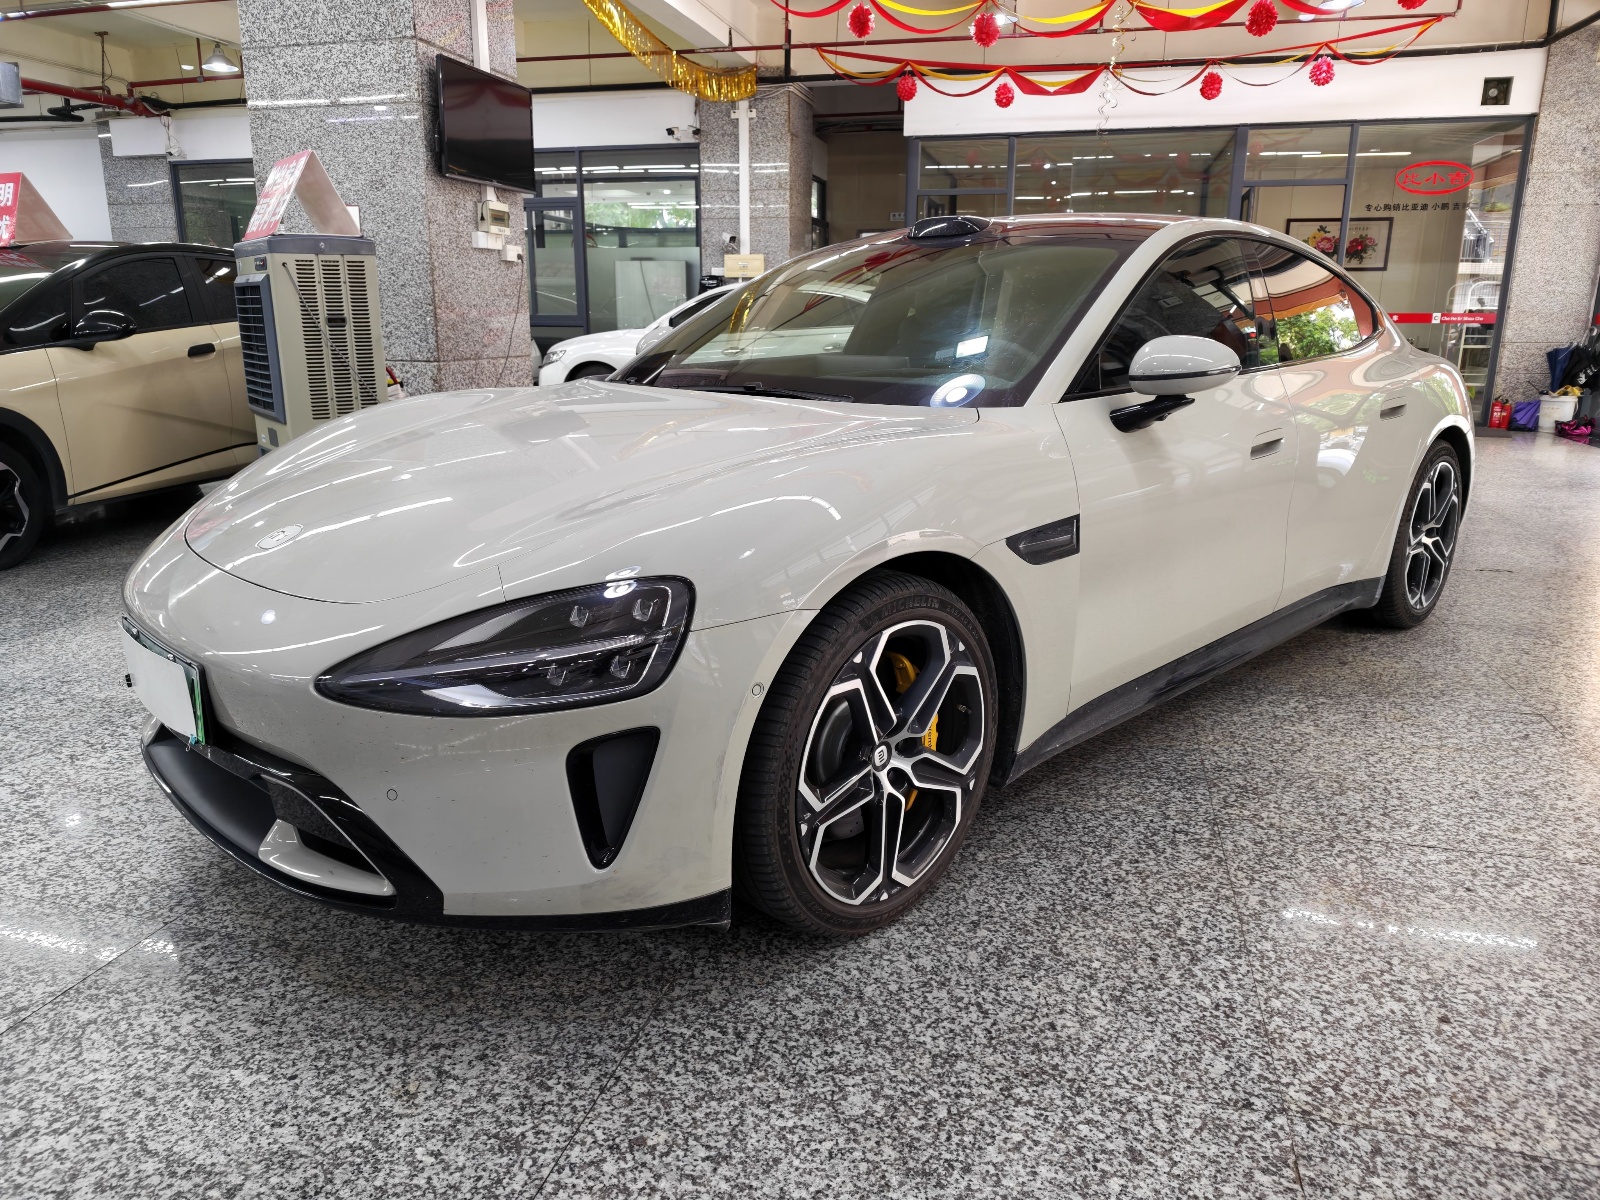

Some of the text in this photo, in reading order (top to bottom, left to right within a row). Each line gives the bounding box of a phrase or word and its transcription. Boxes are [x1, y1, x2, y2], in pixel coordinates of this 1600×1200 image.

[1402, 170, 1470, 186] 比小吉
[1364, 202, 1429, 212] 专心购销比亚迪
[1431, 202, 1450, 211] 小鹏
[881, 595, 941, 618] MICHELIN
